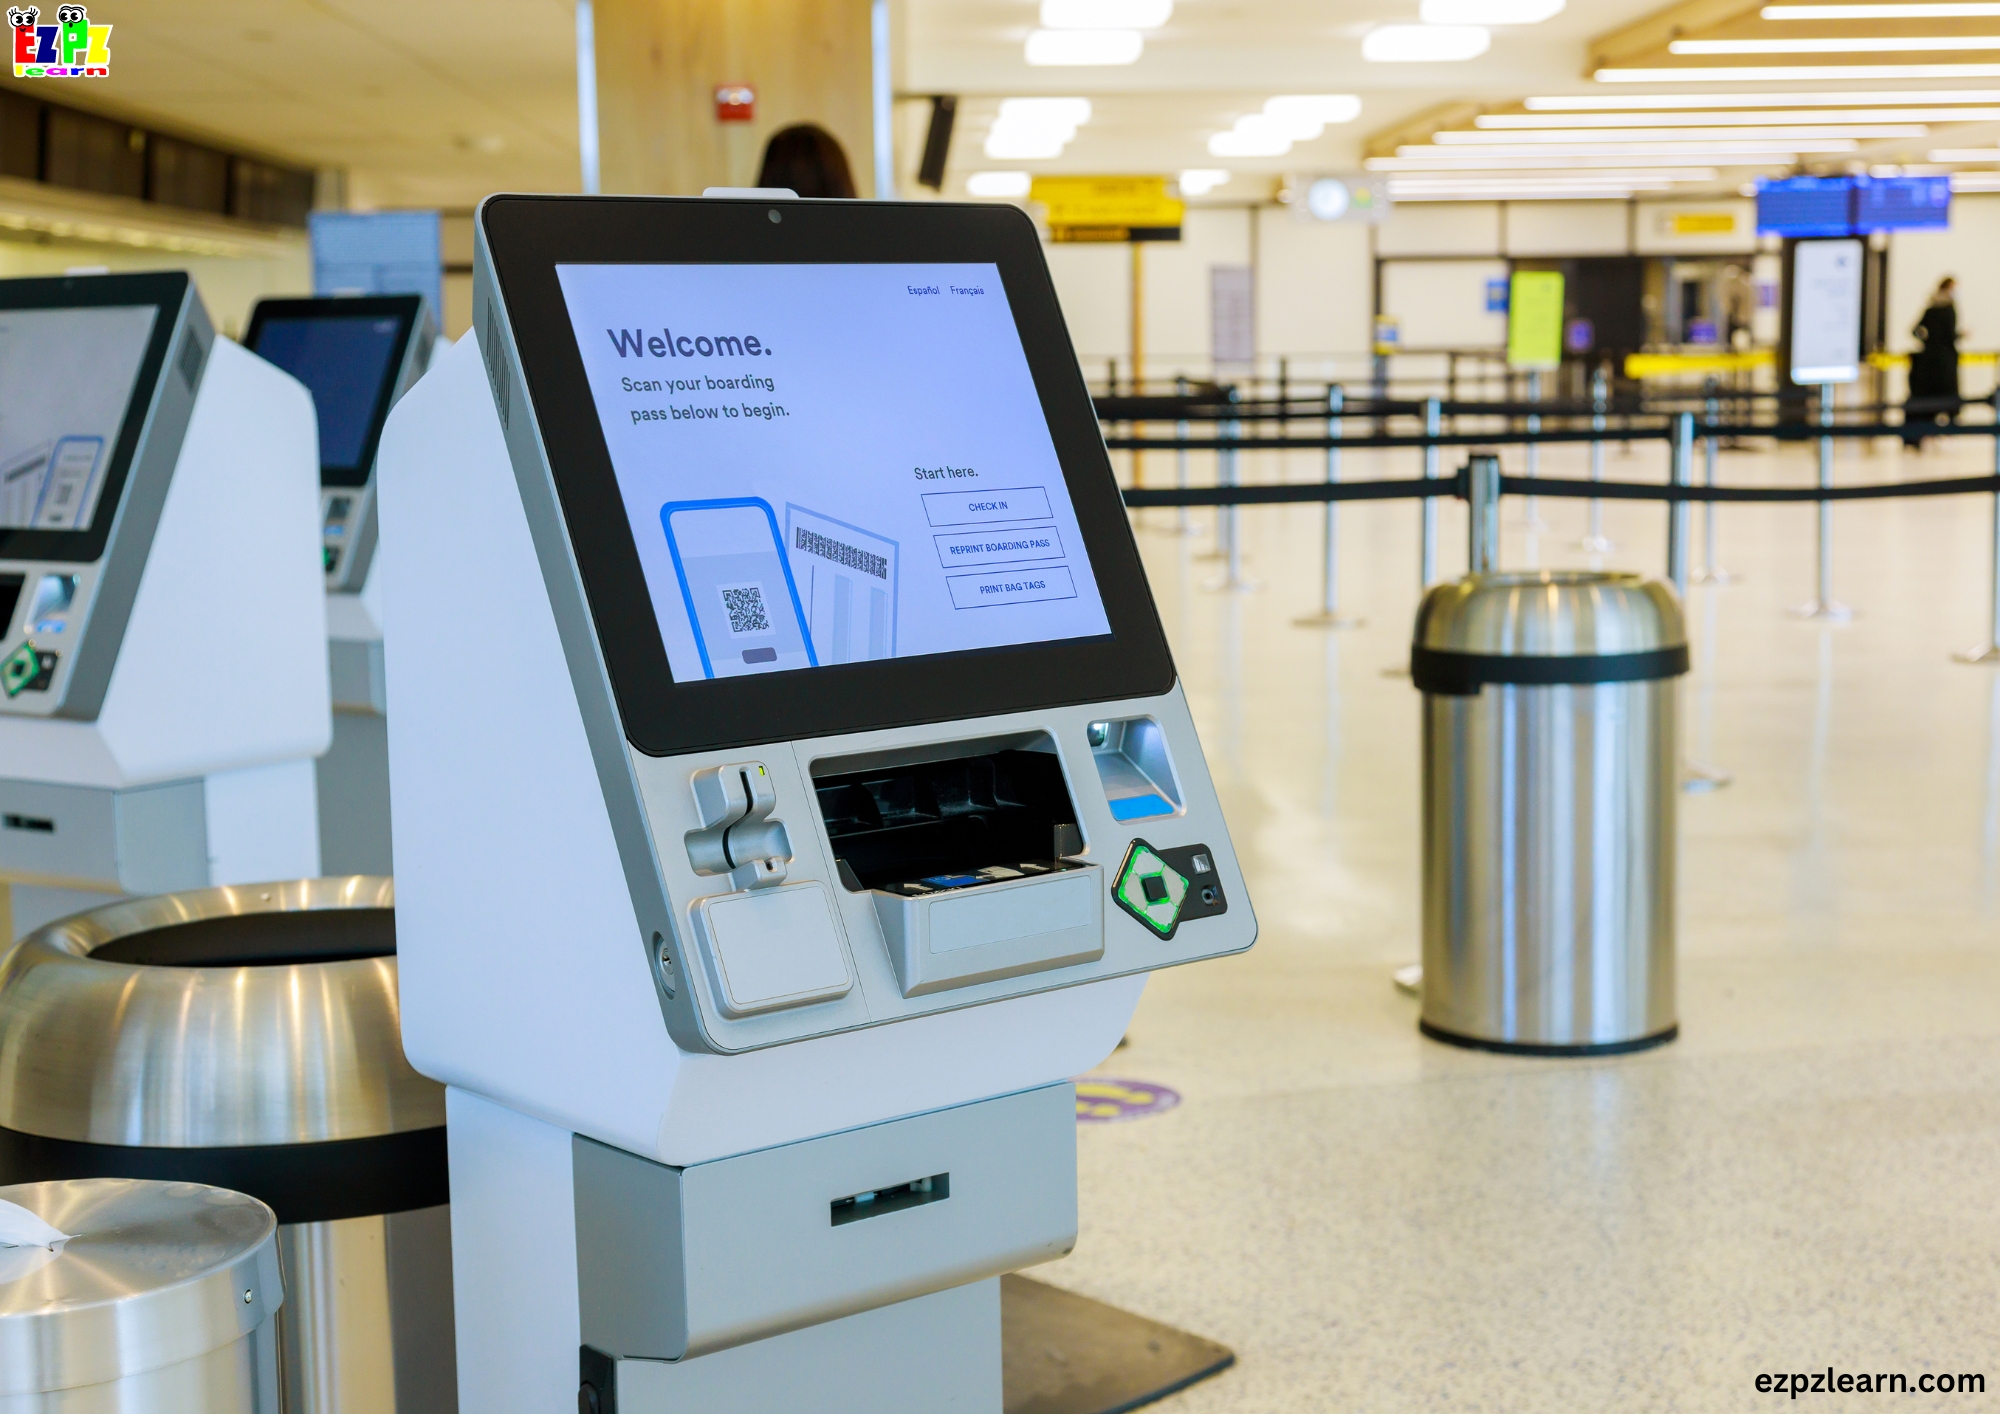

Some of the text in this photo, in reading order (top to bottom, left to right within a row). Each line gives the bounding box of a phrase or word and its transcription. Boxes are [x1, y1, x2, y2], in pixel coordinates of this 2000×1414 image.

[907, 285, 985, 296] Español Français
[606, 327, 772, 358] Welcome.
[621, 374, 775, 395] Scan your boarding
[630, 402, 790, 425] pass below to begin.
[914, 465, 979, 480] Start here.
[968, 501, 1008, 512] CHECK IN
[949, 539, 1050, 555] REPRINT BOARDING PASS
[979, 580, 1046, 595] PRINT BAG TAGS
